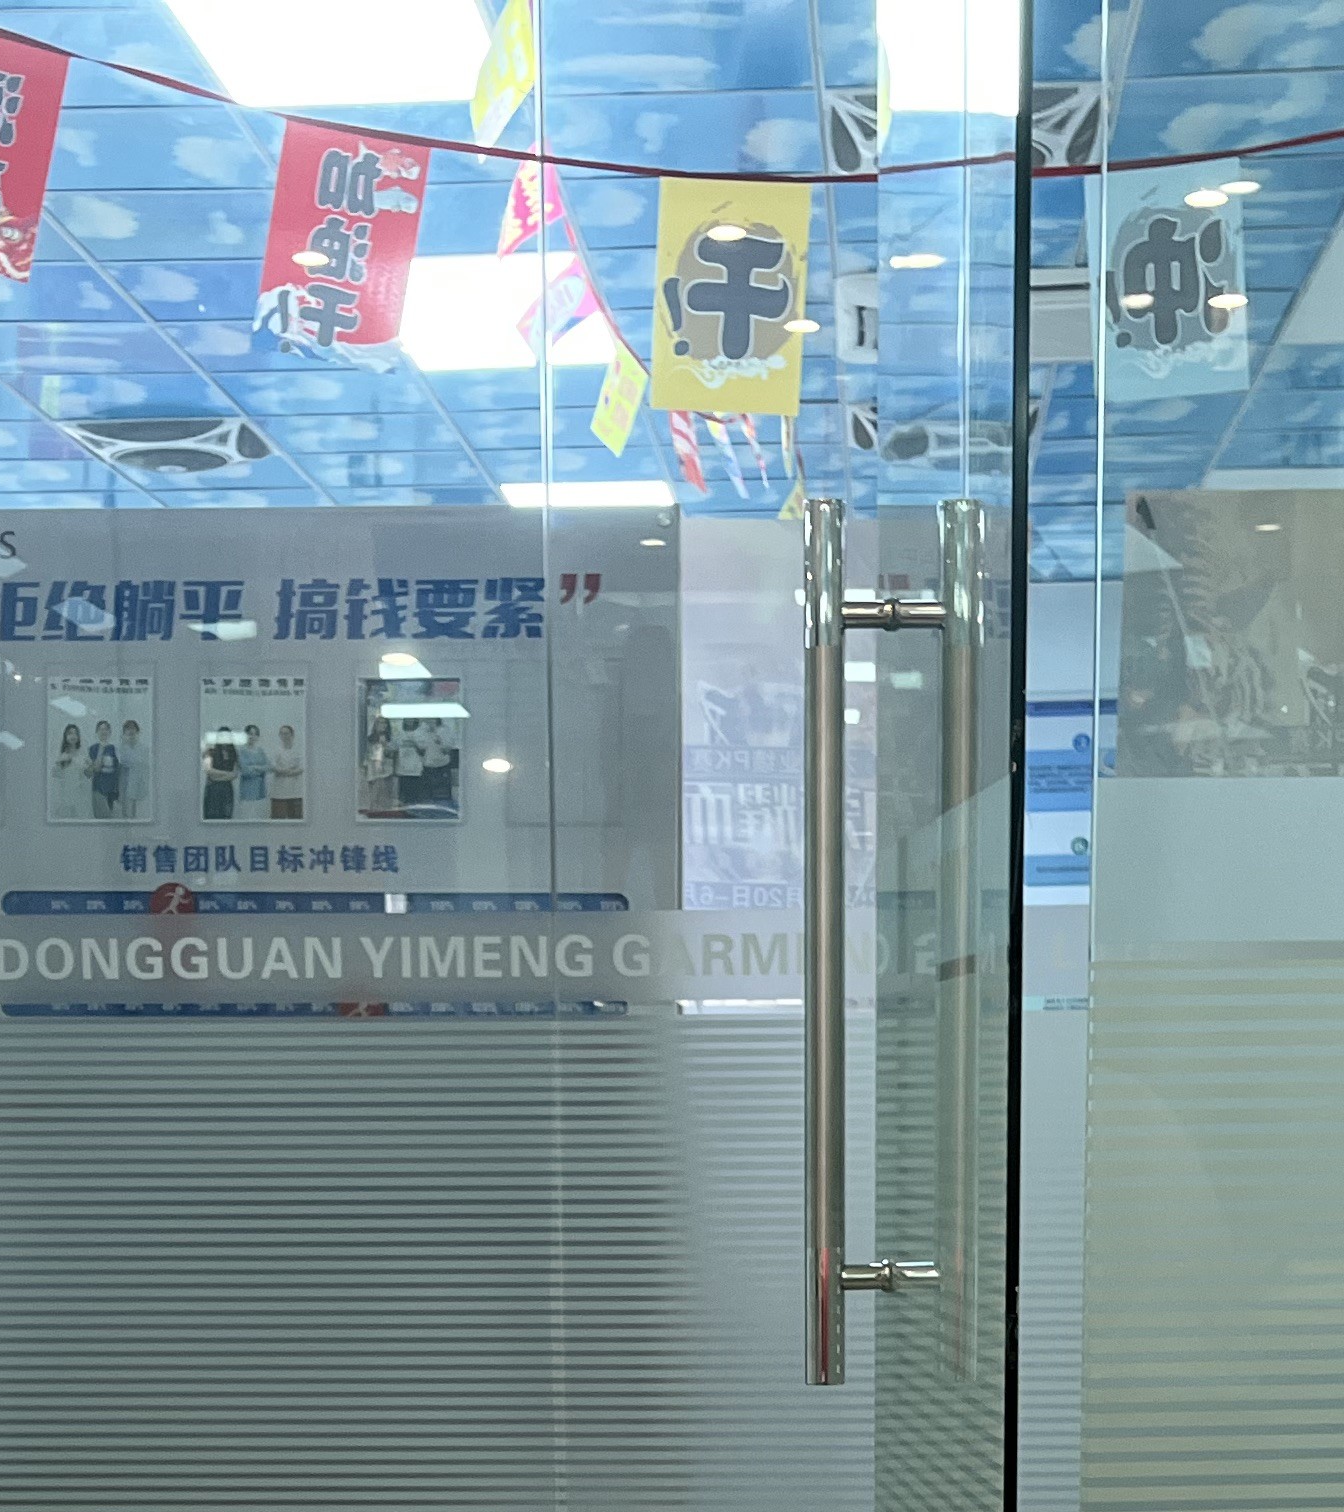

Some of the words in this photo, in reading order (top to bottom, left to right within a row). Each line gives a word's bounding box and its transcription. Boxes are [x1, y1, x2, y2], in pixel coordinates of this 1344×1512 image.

[121, 844, 400, 874] 销售团队目标冲锋线
[360, 934, 594, 979] YIMENG
